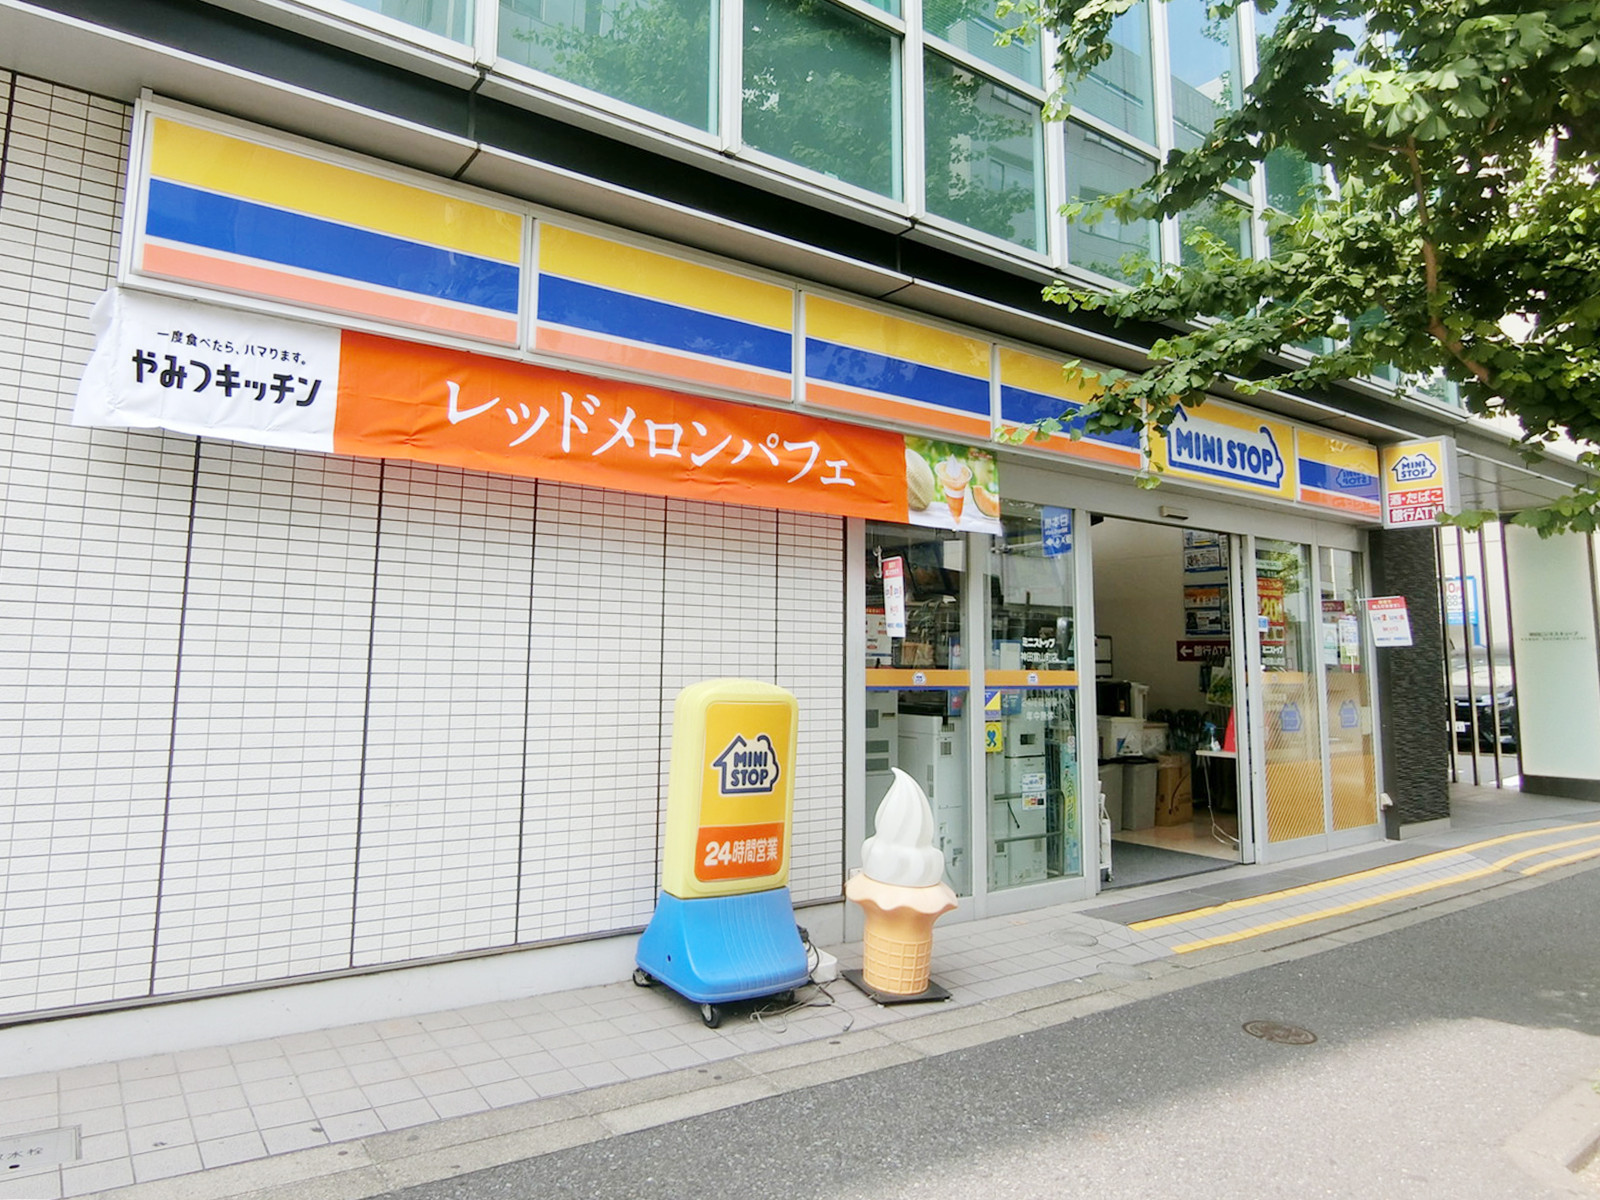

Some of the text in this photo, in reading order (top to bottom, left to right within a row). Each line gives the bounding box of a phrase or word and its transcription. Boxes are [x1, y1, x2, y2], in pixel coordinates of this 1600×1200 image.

[157, 329, 308, 366] 一度食べたら、ハマります。
[132, 349, 321, 407] やみつキッチン
[446, 380, 857, 488] レッドメロンパフェ
[1176, 427, 1274, 477] MINI STOP
[1401, 460, 1426, 470] MINI
[1401, 468, 1428, 478] STOP
[733, 750, 768, 768] MINI
[730, 768, 769, 786] STOP
[703, 838, 779, 867] 24時間営業
